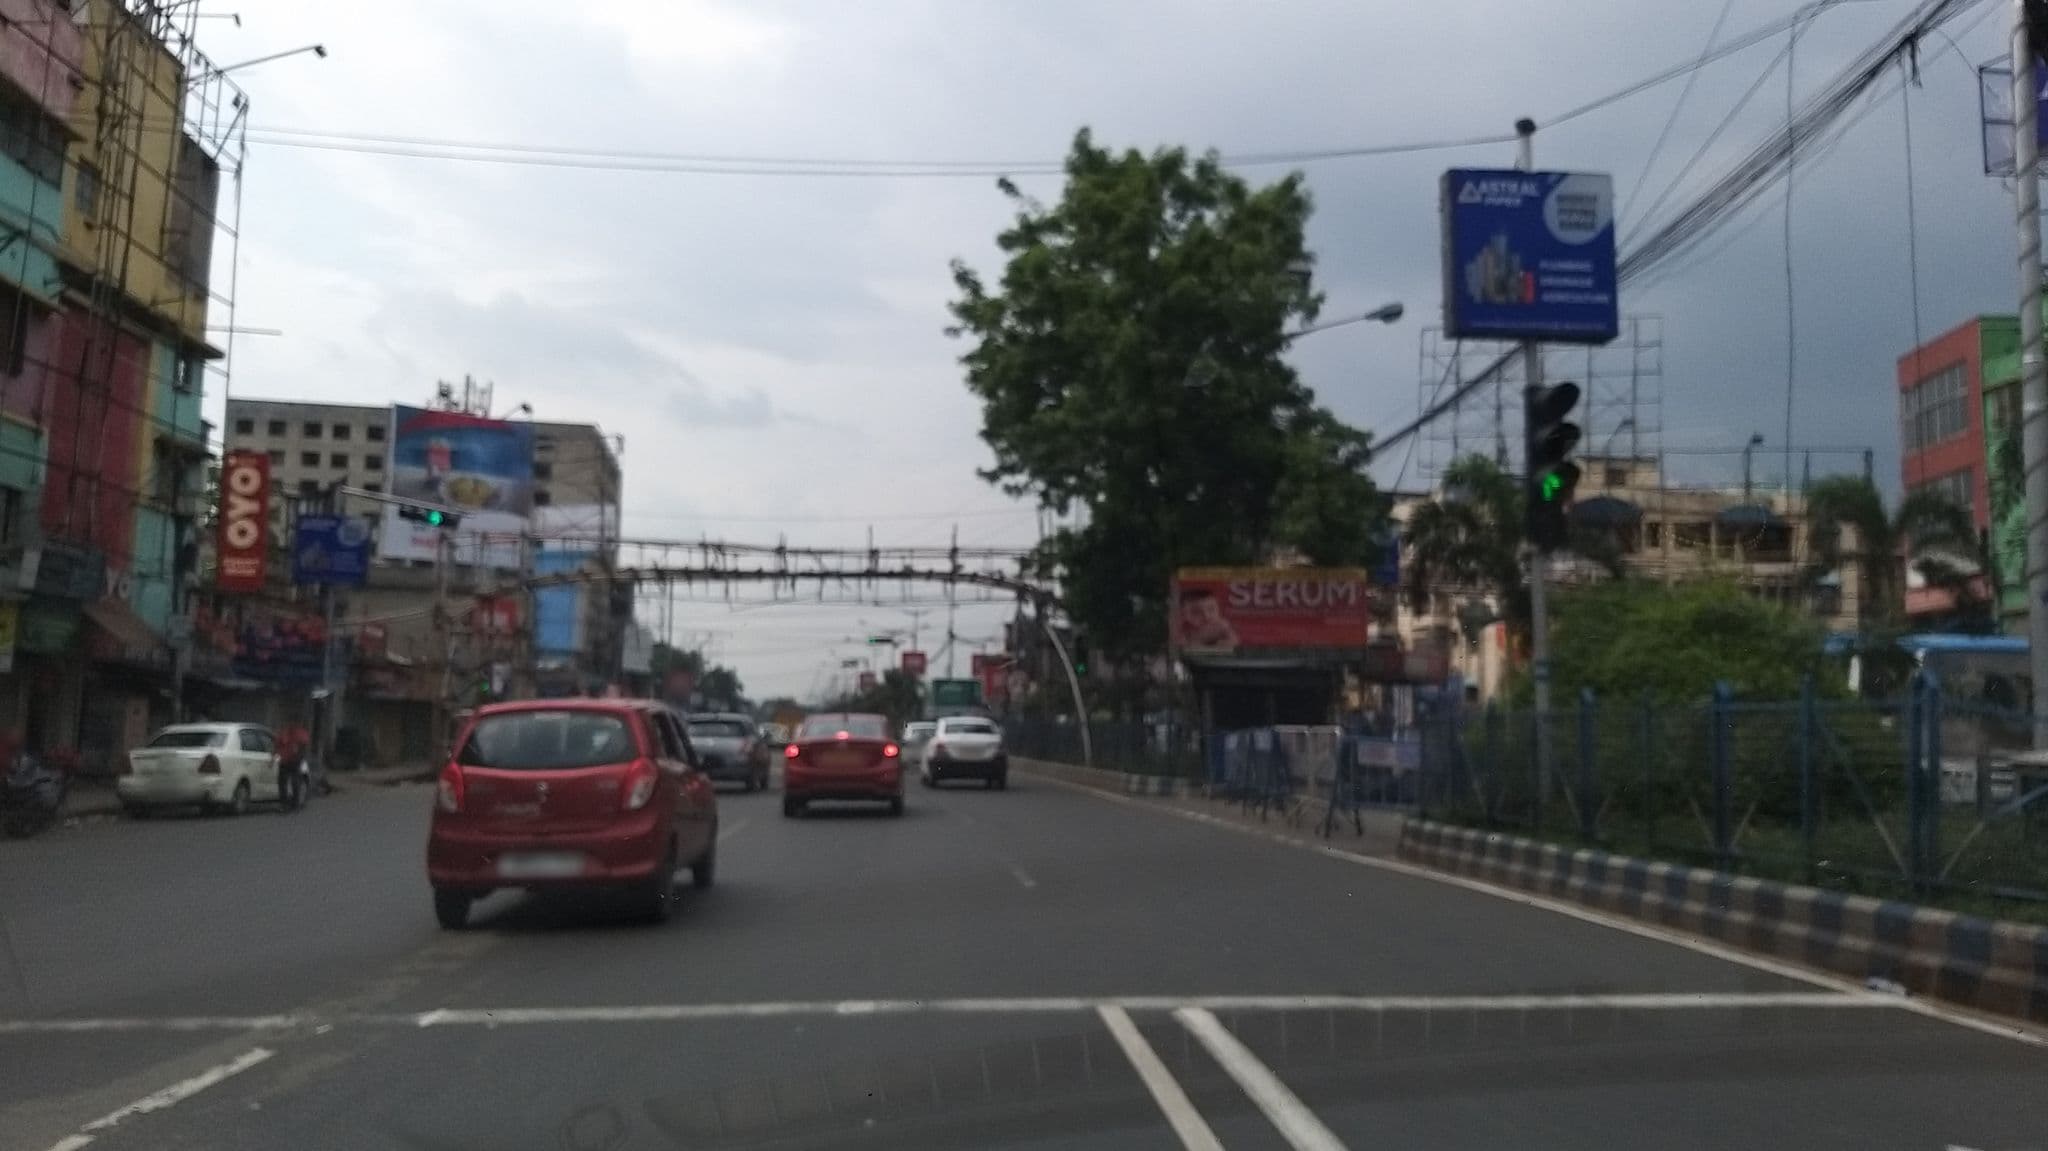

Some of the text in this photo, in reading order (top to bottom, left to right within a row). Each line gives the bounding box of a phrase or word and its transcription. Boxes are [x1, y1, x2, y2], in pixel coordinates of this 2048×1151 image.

[1478, 180, 1539, 197] ASTRAL
[226, 466, 262, 549] OYO
[1229, 579, 1356, 607] SERUM
